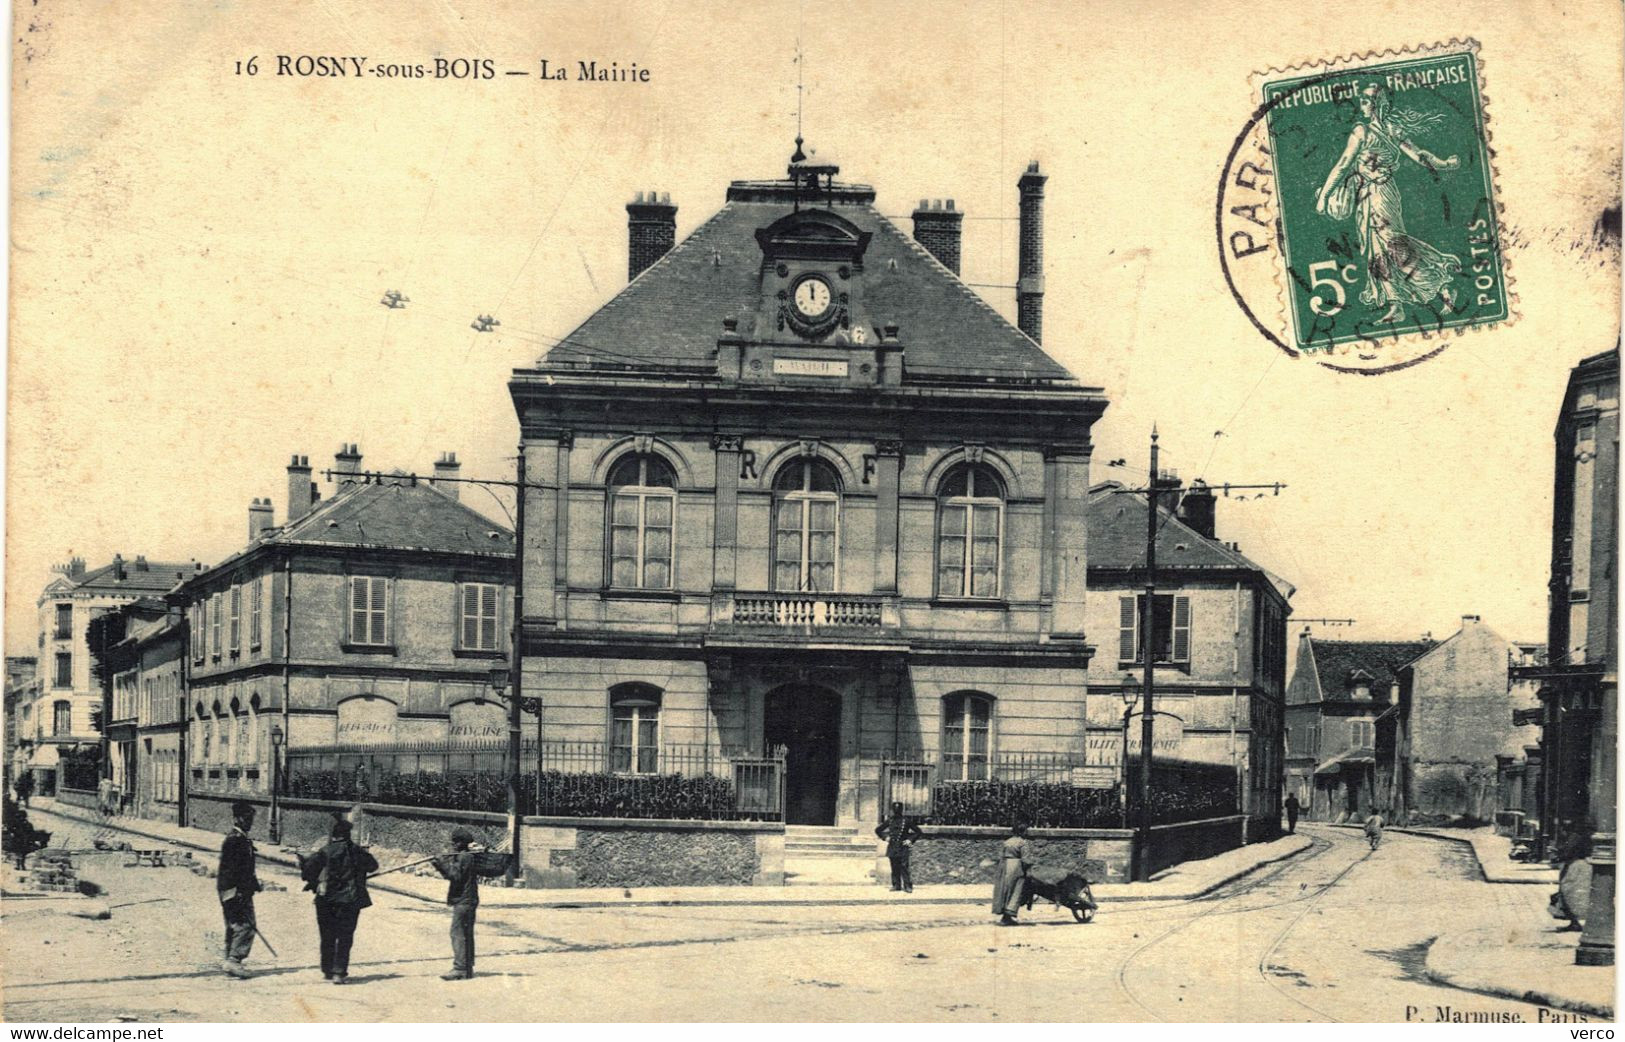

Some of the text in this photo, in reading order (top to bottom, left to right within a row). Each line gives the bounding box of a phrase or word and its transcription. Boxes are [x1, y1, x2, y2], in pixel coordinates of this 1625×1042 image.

[234, 55, 651, 83] 16 ROSNY-sous-BOIS La Mairie
[1468, 218, 1496, 306] POSTES
[740, 450, 878, 485] R F
